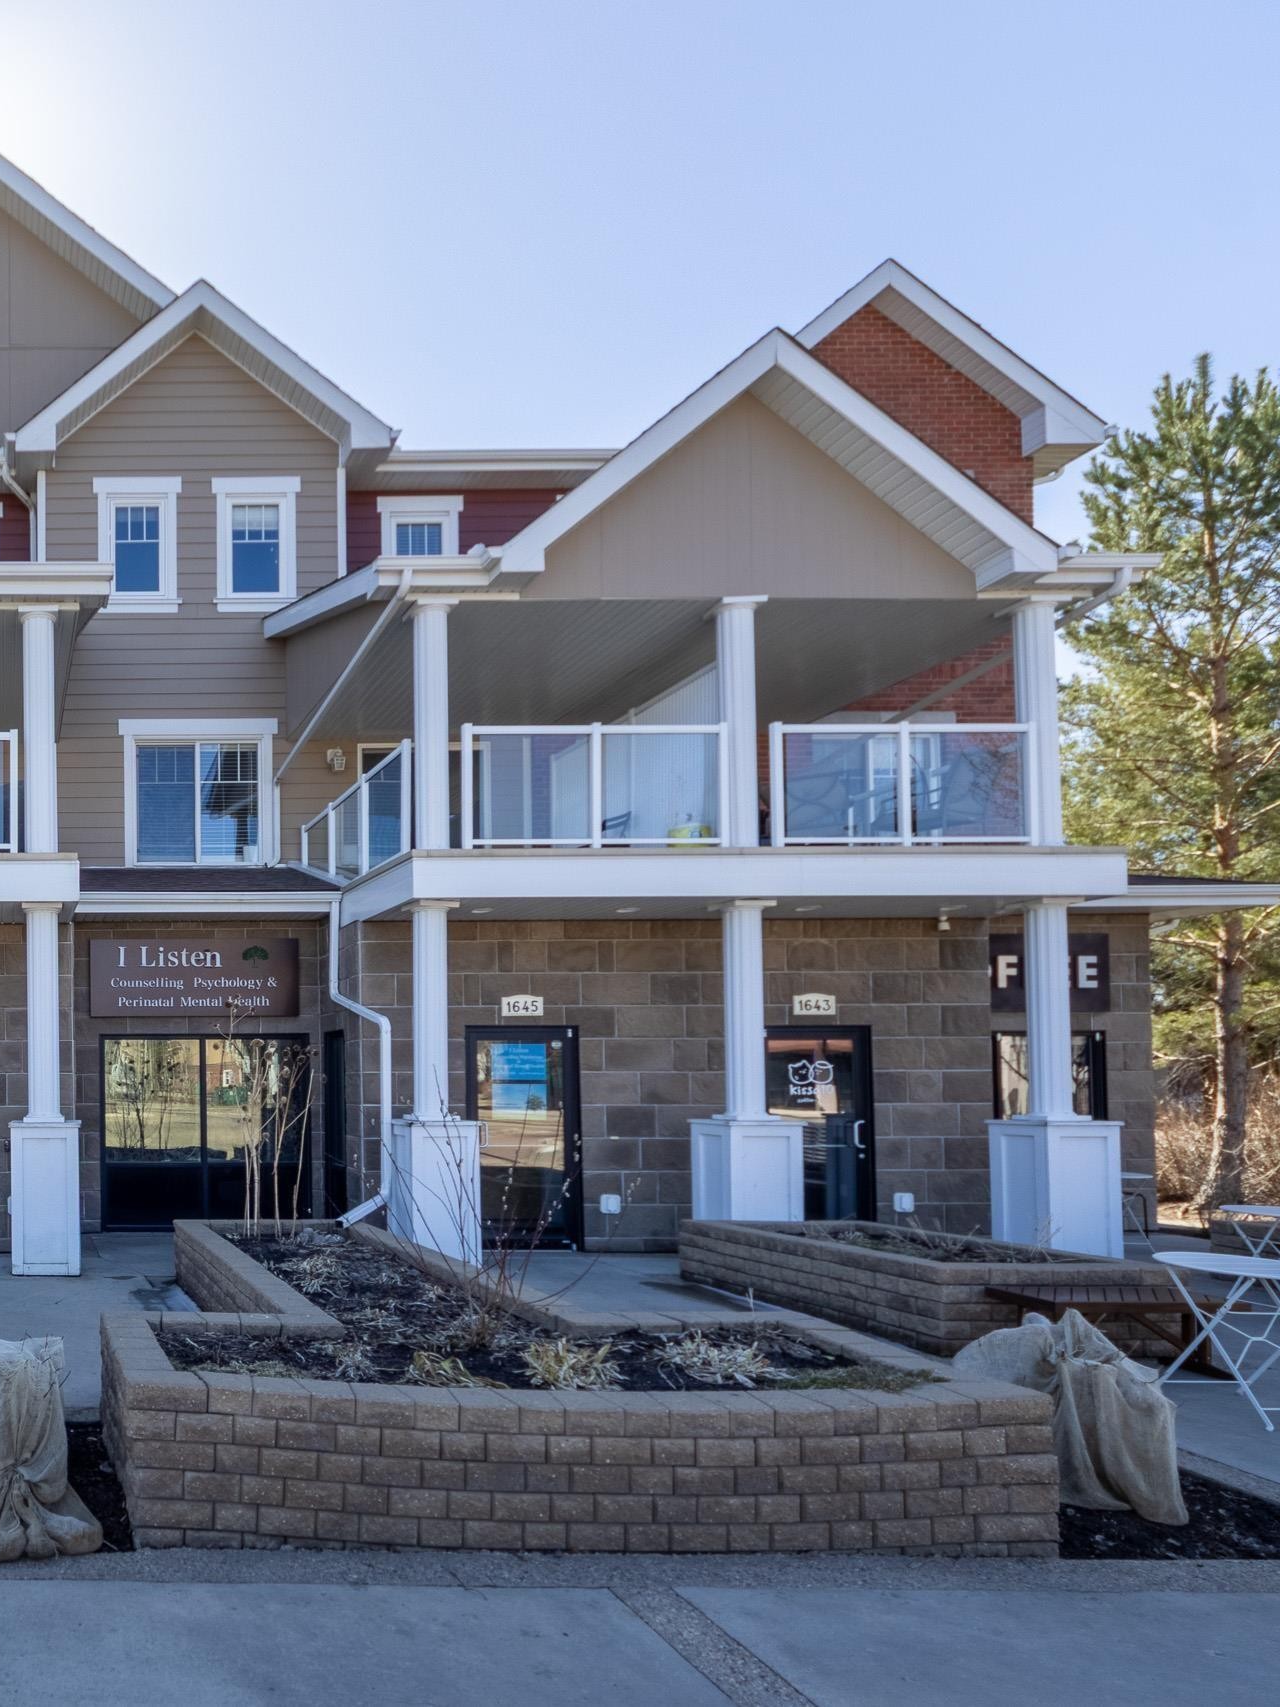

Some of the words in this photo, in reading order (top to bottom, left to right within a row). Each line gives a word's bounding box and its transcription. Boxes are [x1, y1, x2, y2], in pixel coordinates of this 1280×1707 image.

[117, 946, 126, 968] I
[140, 946, 223, 968] Listen
[111, 977, 184, 989] Counselling
[193, 977, 263, 989] Psychology
[267, 977, 277, 987] &
[118, 996, 174, 1007] Perinatal
[180, 996, 223, 1007] Mental
[506, 1001, 539, 1013] 1645
[798, 1000, 831, 1011] 1643
